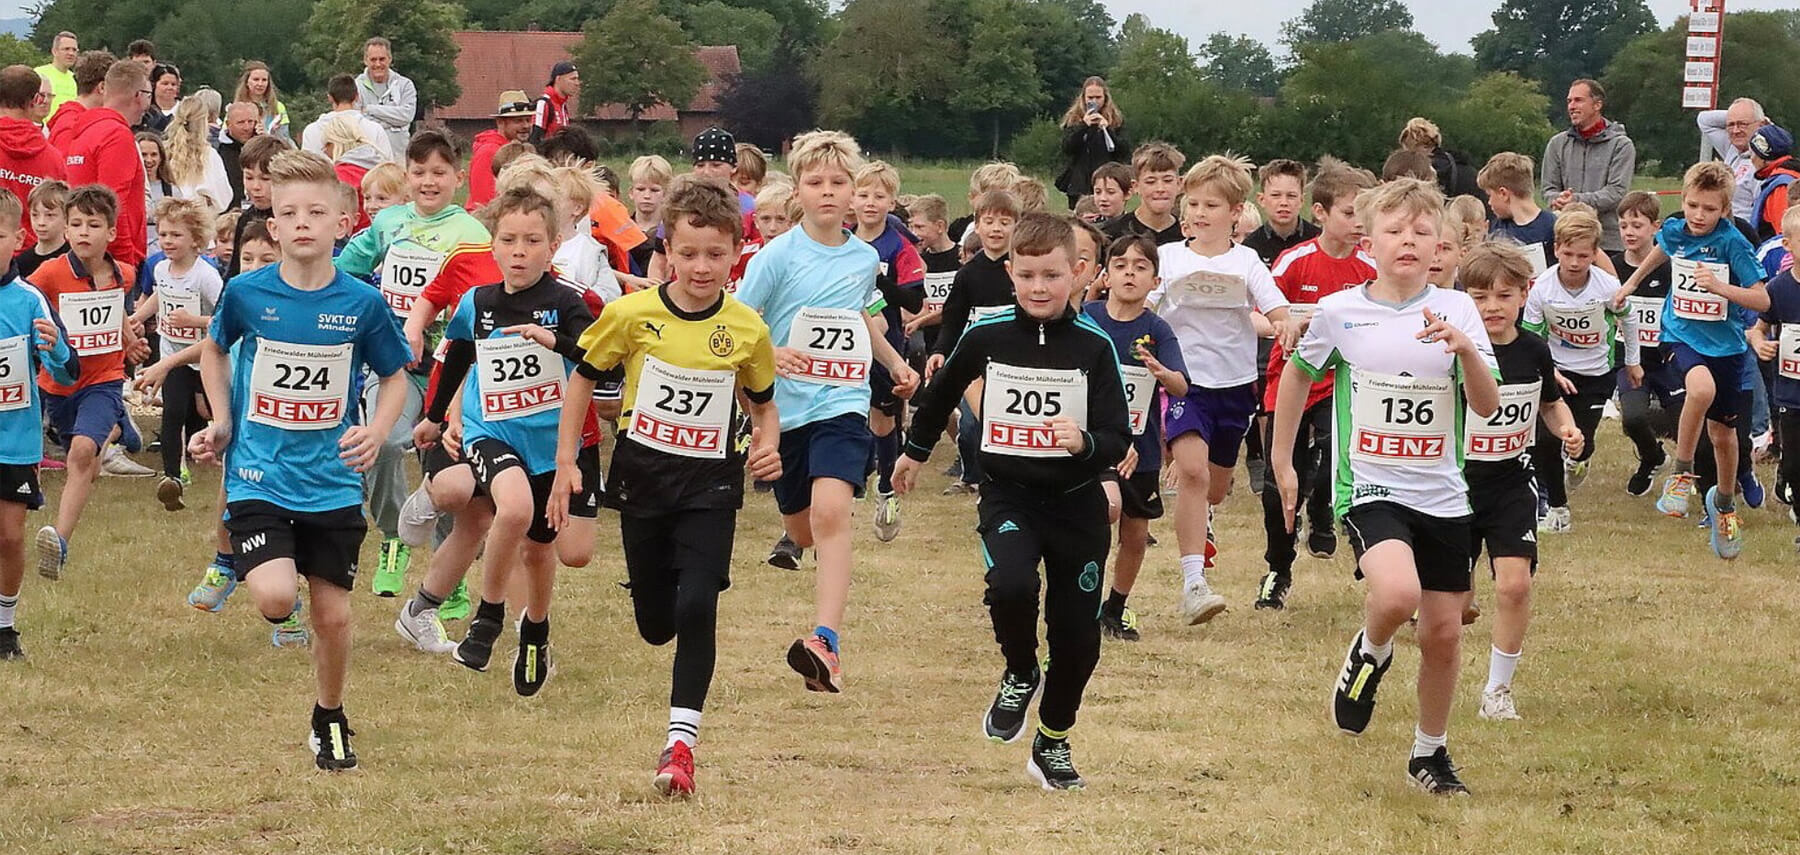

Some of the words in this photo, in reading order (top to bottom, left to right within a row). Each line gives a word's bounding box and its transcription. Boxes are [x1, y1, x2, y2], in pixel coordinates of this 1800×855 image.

[392, 264, 427, 287] 105
[79, 305, 112, 326] 107
[1673, 297, 1720, 314] JENZ
[318, 313, 344, 325] SVKT
[345, 316, 358, 325] 07
[1555, 315, 1590, 330] 206
[1637, 309, 1656, 324] 18
[318, 323, 357, 332] Minden
[1640, 331, 1660, 342] NZ
[69, 332, 117, 348] JENZ
[808, 326, 855, 351] 273
[264, 346, 307, 358] Friedewalder
[307, 350, 343, 358] Mühlenlauf
[272, 363, 330, 391] 224
[491, 354, 542, 383] 328
[651, 364, 691, 381] Friedewalder
[811, 360, 864, 379] ENZ
[996, 371, 1035, 382] Friedewalder
[1036, 376, 1074, 384] Mühlenlauf
[1126, 383, 1136, 402] 8
[1369, 379, 1412, 390] Friedewalder
[1412, 382, 1448, 391] Mühlenlauf
[487, 384, 558, 411] JENZ
[655, 384, 714, 417] 237
[1005, 388, 1061, 417] 205
[259, 397, 338, 420] JENZ
[1381, 397, 1434, 425] 136
[1487, 401, 1532, 426] 290
[636, 416, 718, 448] JENZ
[992, 425, 1053, 446] JEN
[1361, 434, 1442, 456] JENZ
[239, 467, 265, 483] NW
[241, 532, 267, 554] NW
